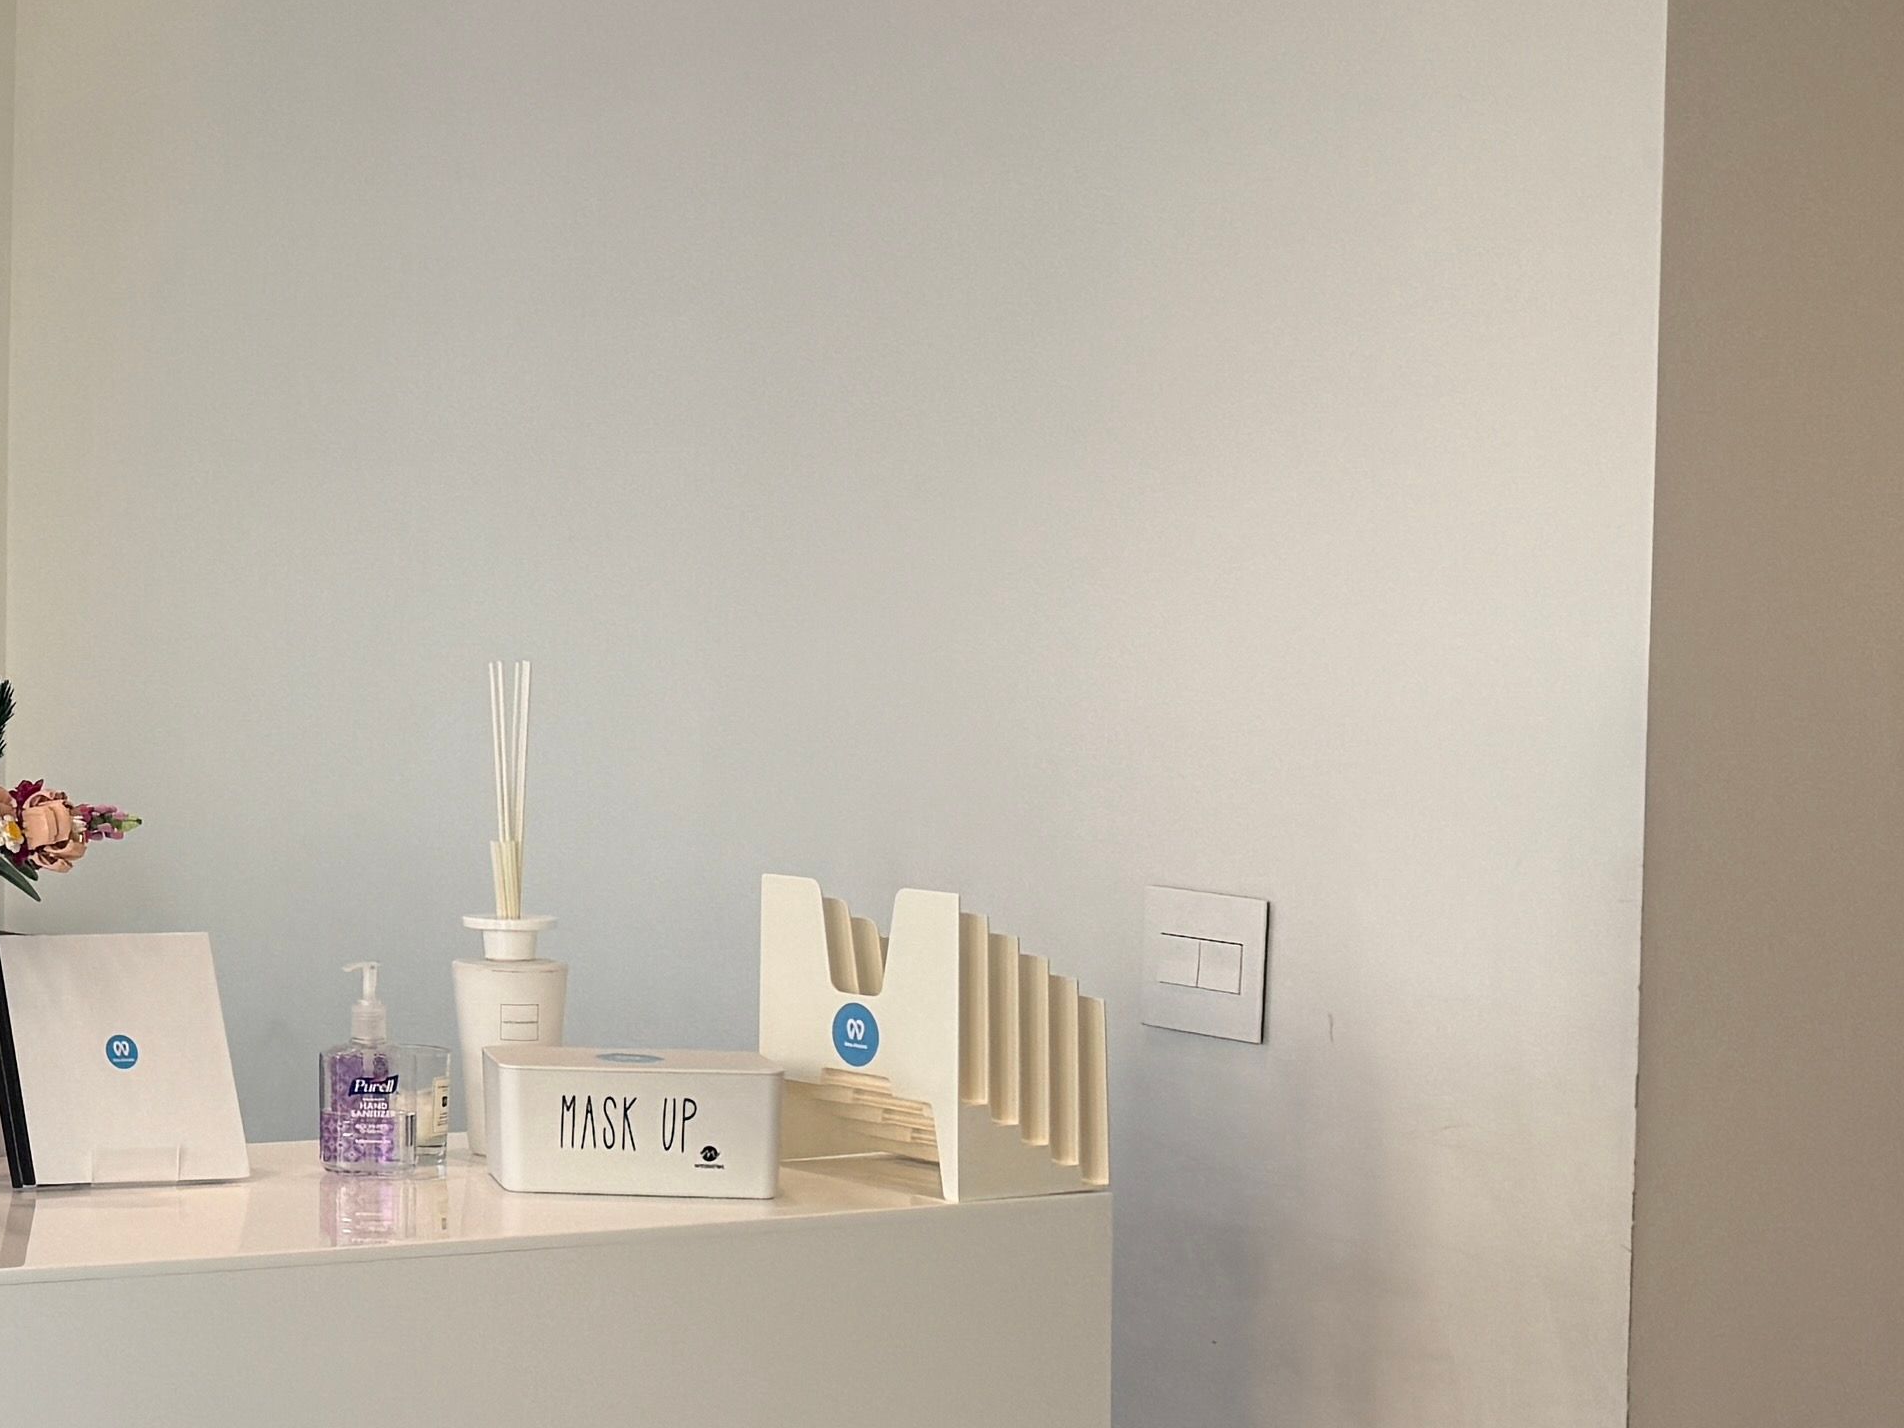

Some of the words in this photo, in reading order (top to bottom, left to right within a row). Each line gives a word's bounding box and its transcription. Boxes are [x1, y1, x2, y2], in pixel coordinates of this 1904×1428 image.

[354, 1079, 395, 1093] Purell
[560, 1094, 638, 1152] MASK
[662, 1097, 698, 1153] UP
